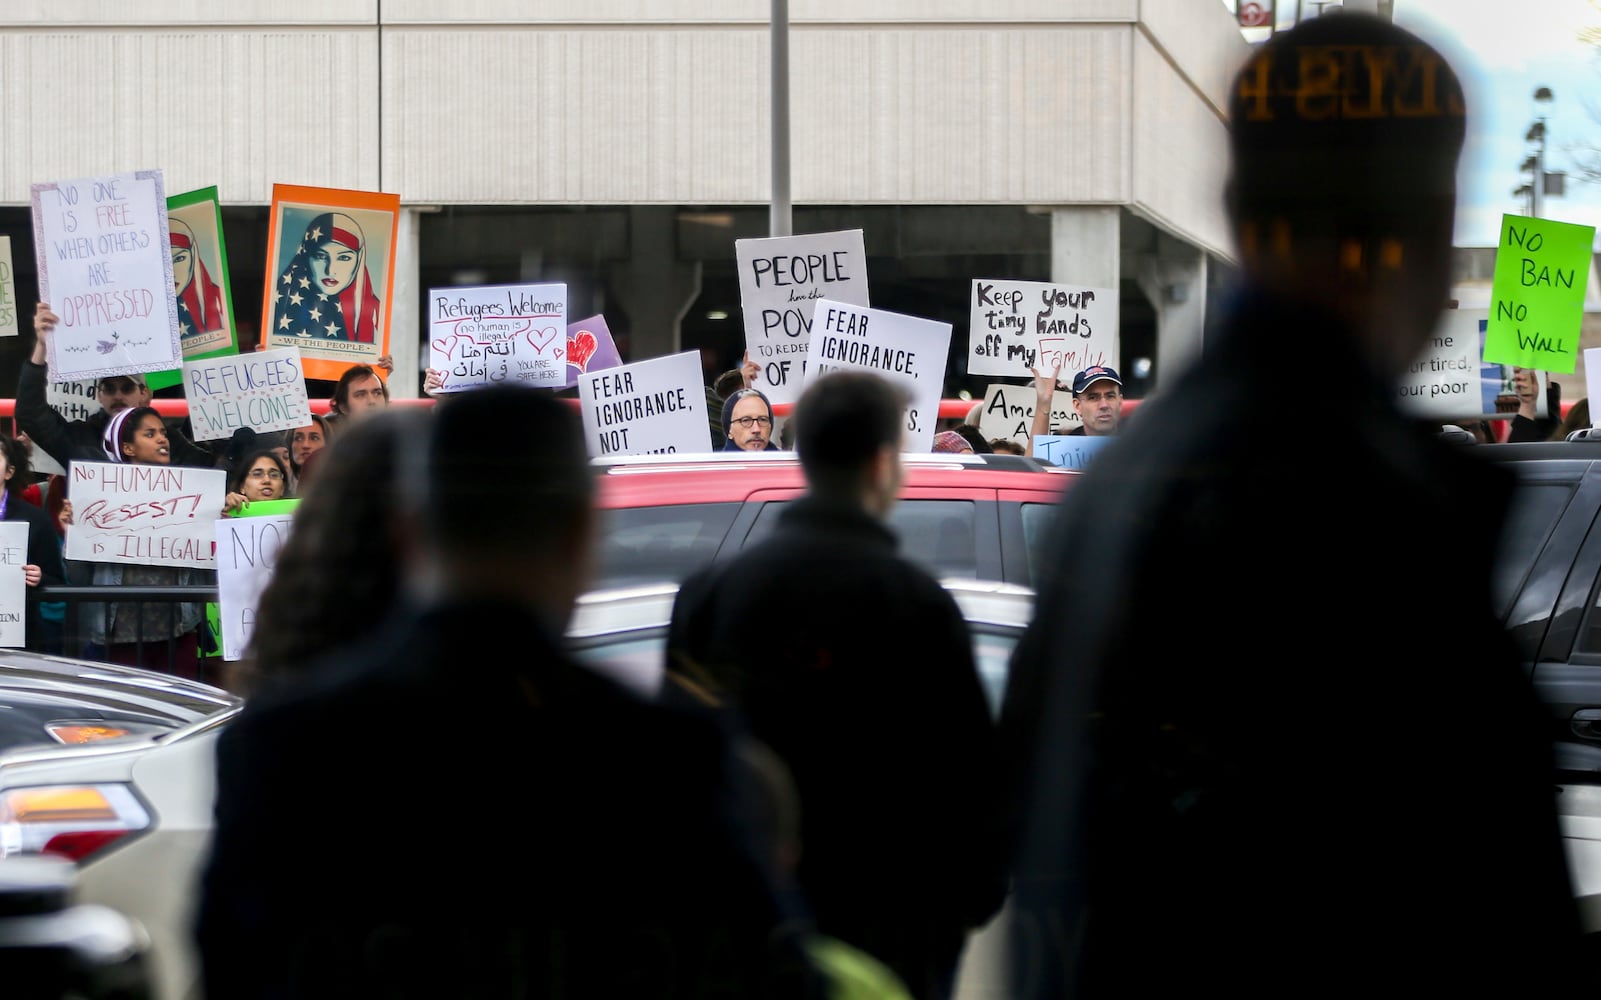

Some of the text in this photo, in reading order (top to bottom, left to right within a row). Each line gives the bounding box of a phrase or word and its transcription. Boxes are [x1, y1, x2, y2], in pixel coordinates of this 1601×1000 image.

[57, 180, 127, 206] NO ONE
[62, 203, 135, 233] IS FREE
[54, 229, 151, 261] WHEN OTHERS
[1508, 225, 1543, 252] NO
[88, 261, 116, 287] ARE
[752, 251, 851, 288] PEOPLE
[1521, 258, 1575, 288] BAN
[63, 288, 154, 328] OPPRESSED
[436, 290, 563, 322] Refugees Welcome
[977, 282, 1095, 317] Keep your
[1498, 300, 1527, 322] NO
[461, 324, 475, 334] no
[477, 322, 510, 332] human
[762, 308, 814, 338] POW
[826, 309, 869, 337] FEAR
[985, 310, 1026, 336] tiny
[301, 340, 322, 348] THE
[326, 340, 366, 352] PEOPLE
[480, 332, 507, 342] illegal
[758, 343, 809, 357] TO REDEE
[1517, 329, 1568, 353] WALL
[517, 359, 551, 370] YOU ARE
[821, 336, 919, 379] IGNORANCE,
[975, 334, 1002, 357] off
[1007, 344, 1036, 368] my
[191, 357, 299, 397] REFUGEES
[516, 370, 560, 380] SAFE HERE
[766, 360, 791, 386] OF
[1409, 361, 1426, 374] ur
[592, 371, 634, 400] FEAR
[1400, 382, 1469, 398] our poor
[200, 393, 299, 431] WELCOME
[596, 388, 692, 428] IGNORANCE,
[599, 428, 629, 454] NOT
[102, 466, 184, 492] HUMAN
[80, 493, 202, 529] RESIST!
[116, 534, 217, 561] ILLEGAL!
